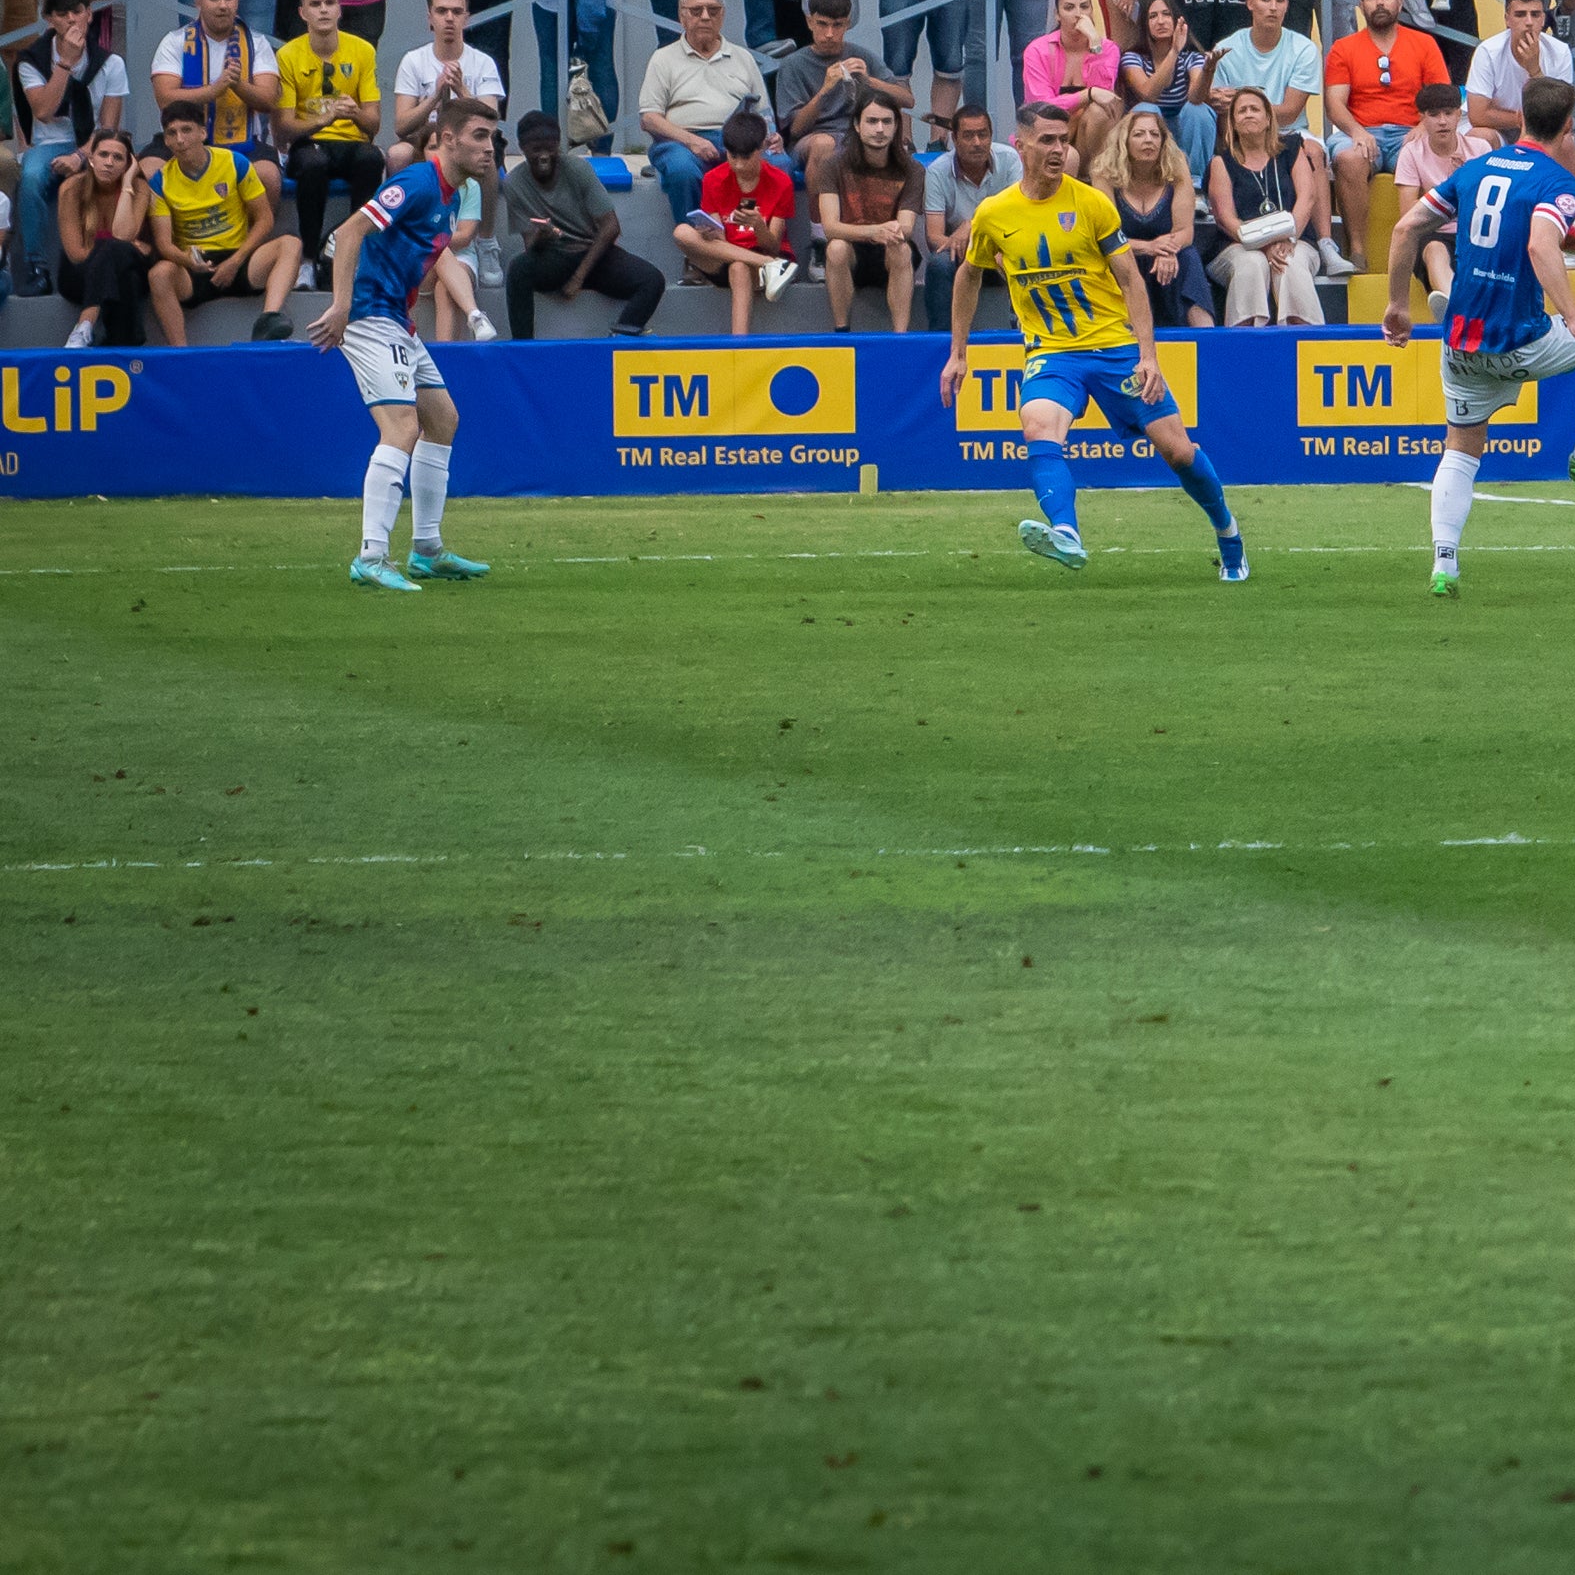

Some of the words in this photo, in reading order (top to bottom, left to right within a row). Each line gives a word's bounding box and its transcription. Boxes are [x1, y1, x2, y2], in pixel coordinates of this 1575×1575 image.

[1470, 175, 1512, 249] 8
[390, 343, 409, 366] 18
[629, 374, 709, 418] TM
[1313, 365, 1393, 408] TM
[616, 447, 652, 466] TM
[659, 445, 707, 466] Real
[714, 446, 783, 465] Estate
[790, 444, 860, 467] Group
[959, 441, 994, 461] TM
[1002, 441, 1028, 459] Re
[1300, 438, 1335, 456] TM
[1343, 436, 1390, 456] Real
[1398, 436, 1448, 455] Esta
[1485, 437, 1542, 458] roup
